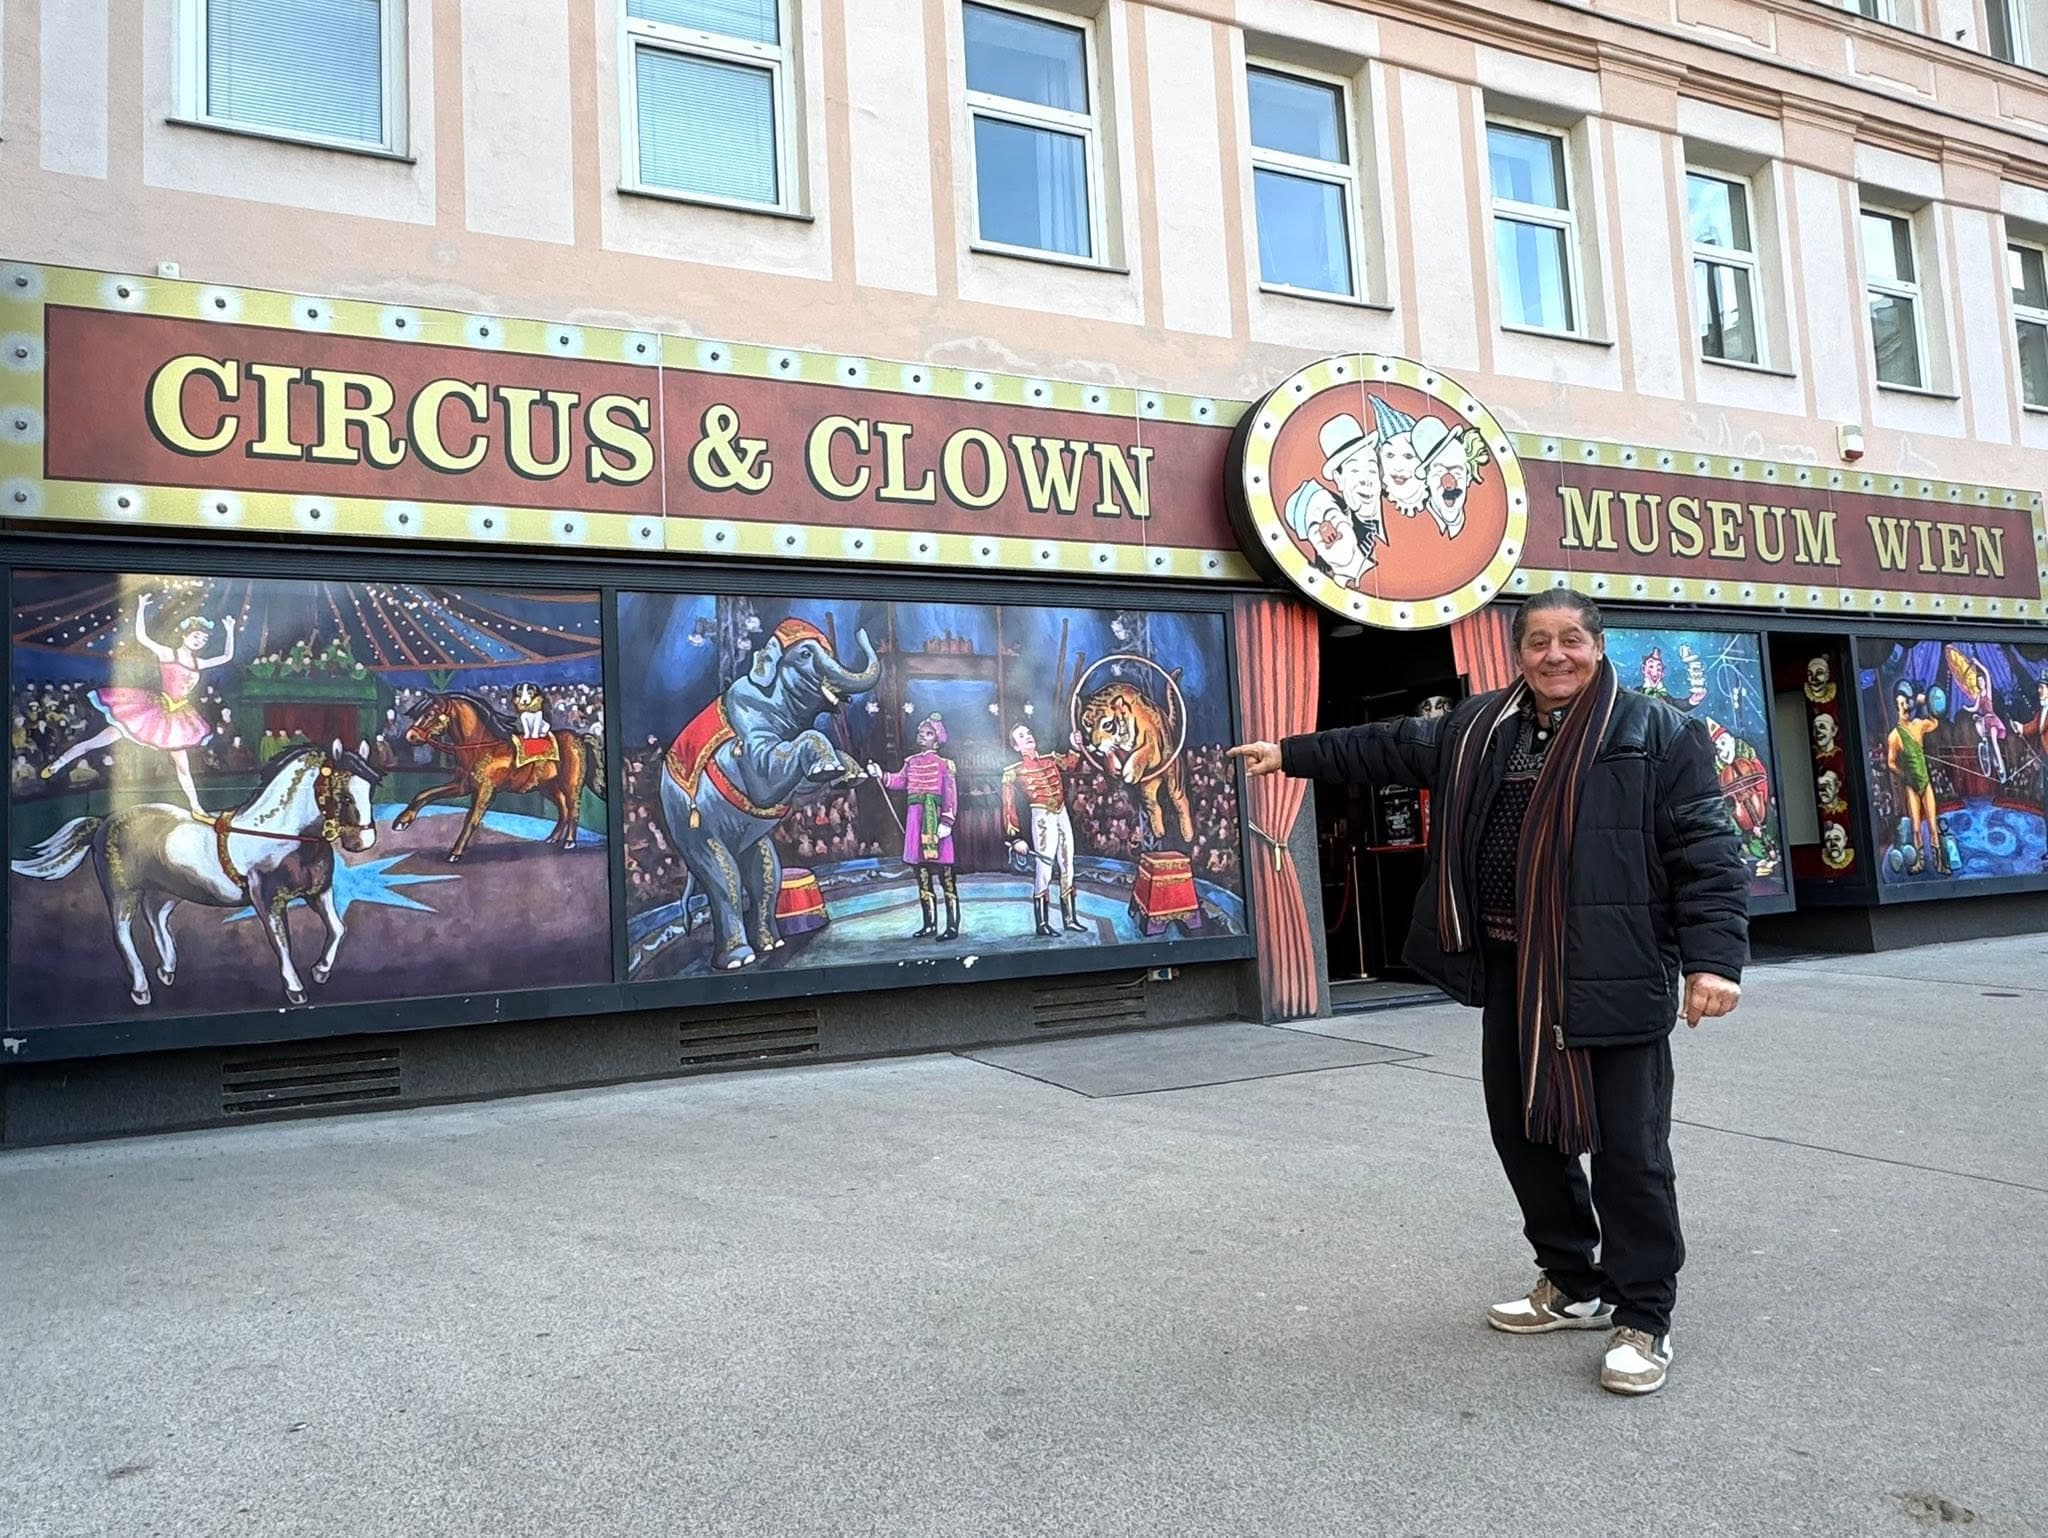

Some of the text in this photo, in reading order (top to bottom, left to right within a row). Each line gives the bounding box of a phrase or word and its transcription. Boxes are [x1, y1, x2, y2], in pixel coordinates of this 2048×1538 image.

[145, 354, 2006, 579] CIRCUS & CLOWN MUSEUM WIEN
